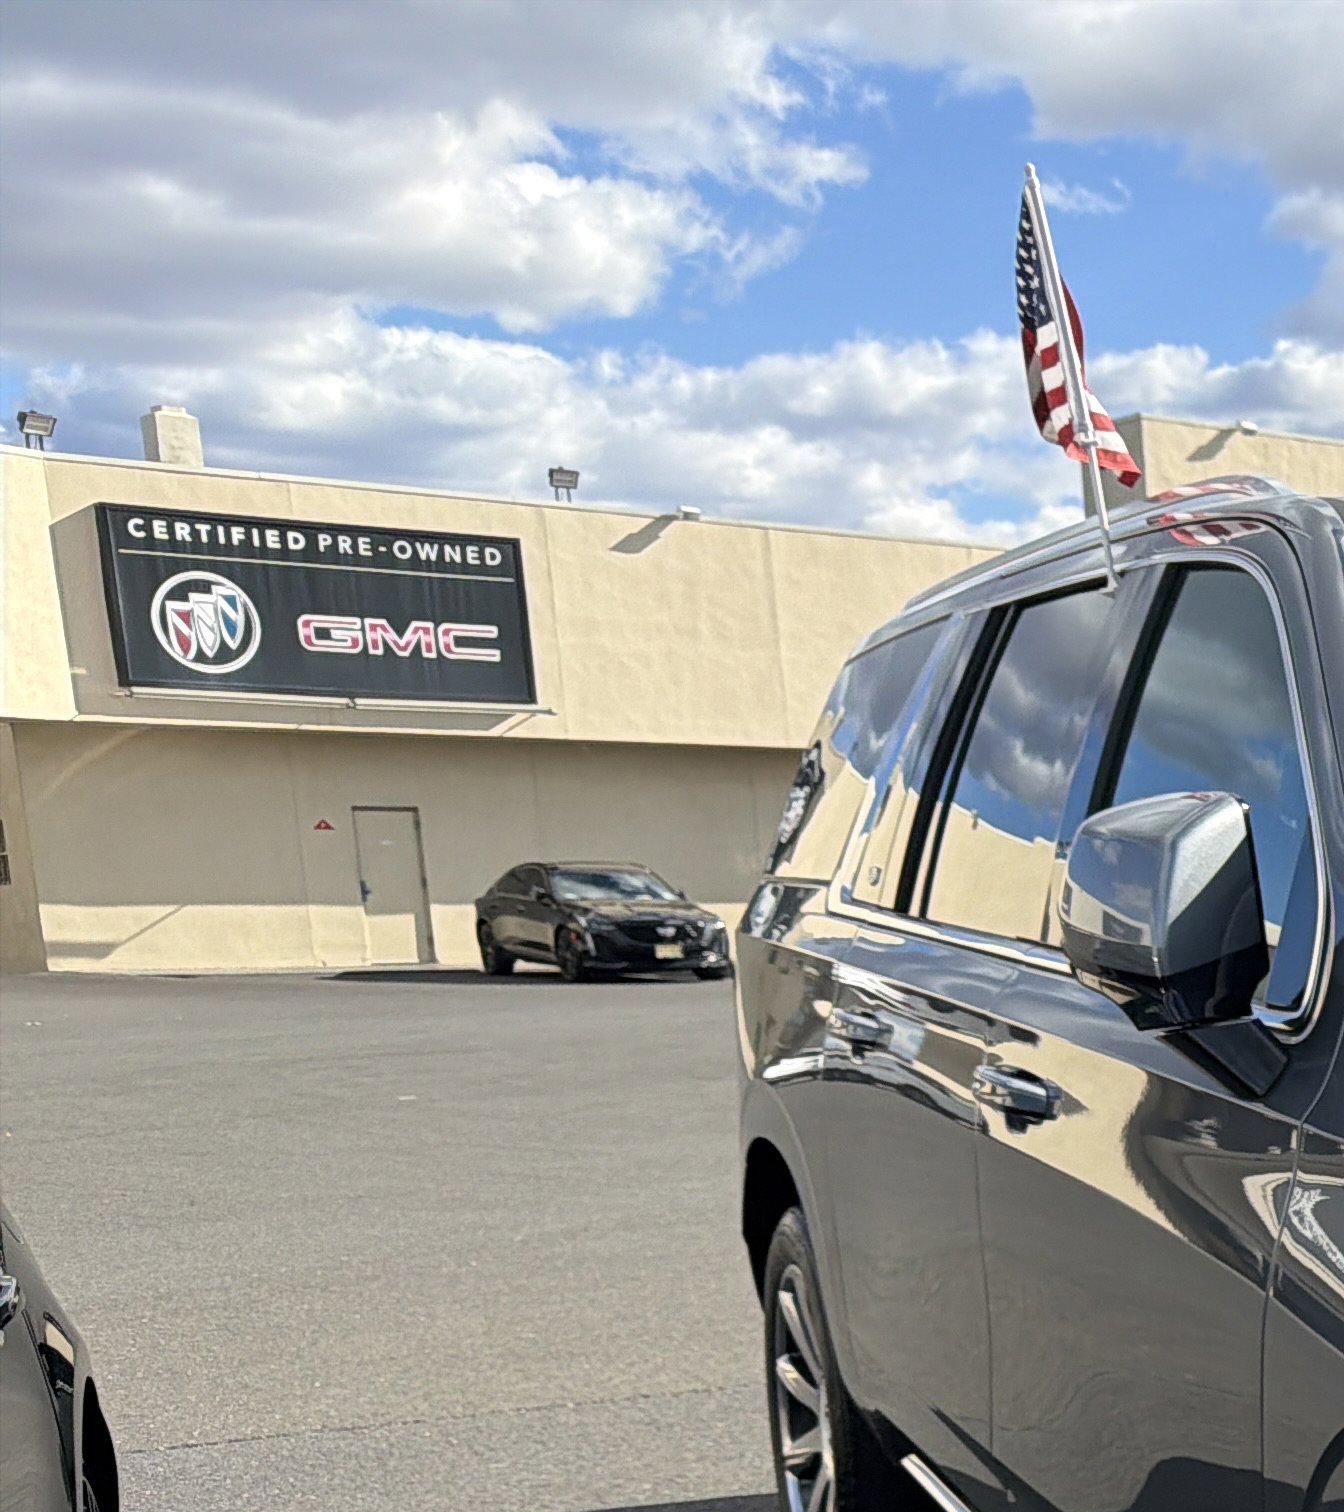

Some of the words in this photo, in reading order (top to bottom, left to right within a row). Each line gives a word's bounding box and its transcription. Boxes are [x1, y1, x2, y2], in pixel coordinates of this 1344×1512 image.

[127, 517, 306, 551] CERTIFIED
[318, 533, 502, 566] PRE-OWNED
[297, 613, 502, 663] GMC
